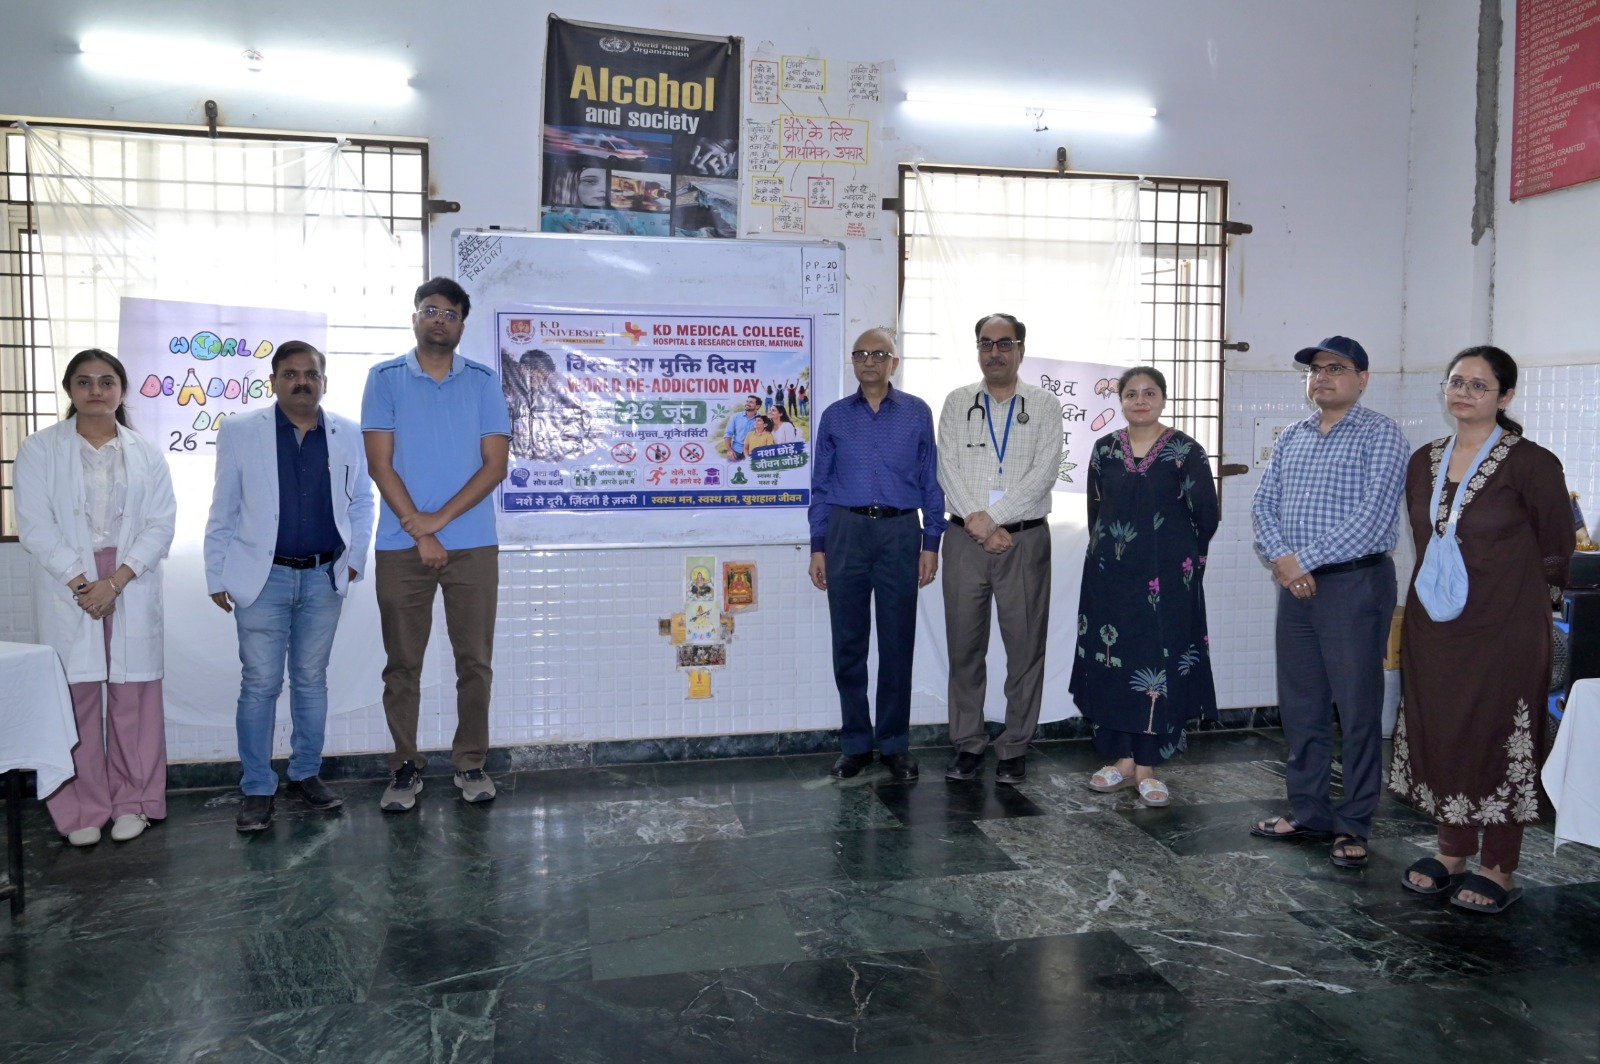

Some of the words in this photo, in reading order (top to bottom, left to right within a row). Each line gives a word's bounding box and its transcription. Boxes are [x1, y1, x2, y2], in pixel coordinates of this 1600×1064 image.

[1557, 13, 1585, 30] SUPPORT
[1540, 27, 1575, 45] FOLLOWING
[633, 41, 659, 49] World
[661, 43, 690, 52] Health
[633, 47, 689, 57] Organization
[1556, 55, 1570, 66] TRIP
[570, 64, 715, 111] Alcohol
[1558, 97, 1579, 110] CURVE
[585, 107, 621, 125] and
[628, 111, 700, 134] society
[1549, 108, 1572, 124] SNEAKY
[808, 119, 823, 140] के
[828, 120, 854, 141] लिए
[1544, 119, 1568, 134] ANSWER
[783, 140, 830, 160] प्राथमिक
[834, 147, 865, 161] उपचार
[1546, 151, 1556, 160] FOR
[1557, 142, 1586, 157] GRANTED
[1546, 157, 1568, 171] LIGHTLY
[466, 242, 502, 281] FRIDAY
[540, 328, 609, 337] UNIVERSITY
[653, 324, 671, 336] KD
[677, 325, 738, 337] MEDICAL
[743, 326, 805, 339] COLLEGE,
[169, 331, 274, 361] WORLD
[653, 337, 689, 346] HOSPITAL
[698, 338, 736, 346] RESEARCH
[737, 339, 767, 348] CENTER,
[768, 339, 804, 348] MATHURA
[659, 353, 702, 377] मुक्ति
[707, 353, 757, 374] दिवस
[140, 368, 274, 406] DE-ADDICT
[567, 377, 622, 393] WORLD
[625, 377, 729, 393] DE-ADDICTION
[733, 378, 761, 393] DAY
[193, 411, 236, 431] DA
[661, 404, 698, 424] जून
[169, 431, 198, 452] 26
[757, 447, 776, 458] नशा
[755, 458, 780, 470] जीवन
[516, 496, 533, 506] नशे
[535, 496, 544, 506] से
[547, 496, 566, 508] दूरी,
[602, 496, 609, 506] है
[651, 496, 676, 504] स्वस्थ
[678, 496, 695, 505] मन,
[698, 495, 722, 504] स्वस्थ
[724, 494, 740, 504] तन,
[742, 494, 776, 506] खुशहाल
[778, 492, 802, 502] जीवन
